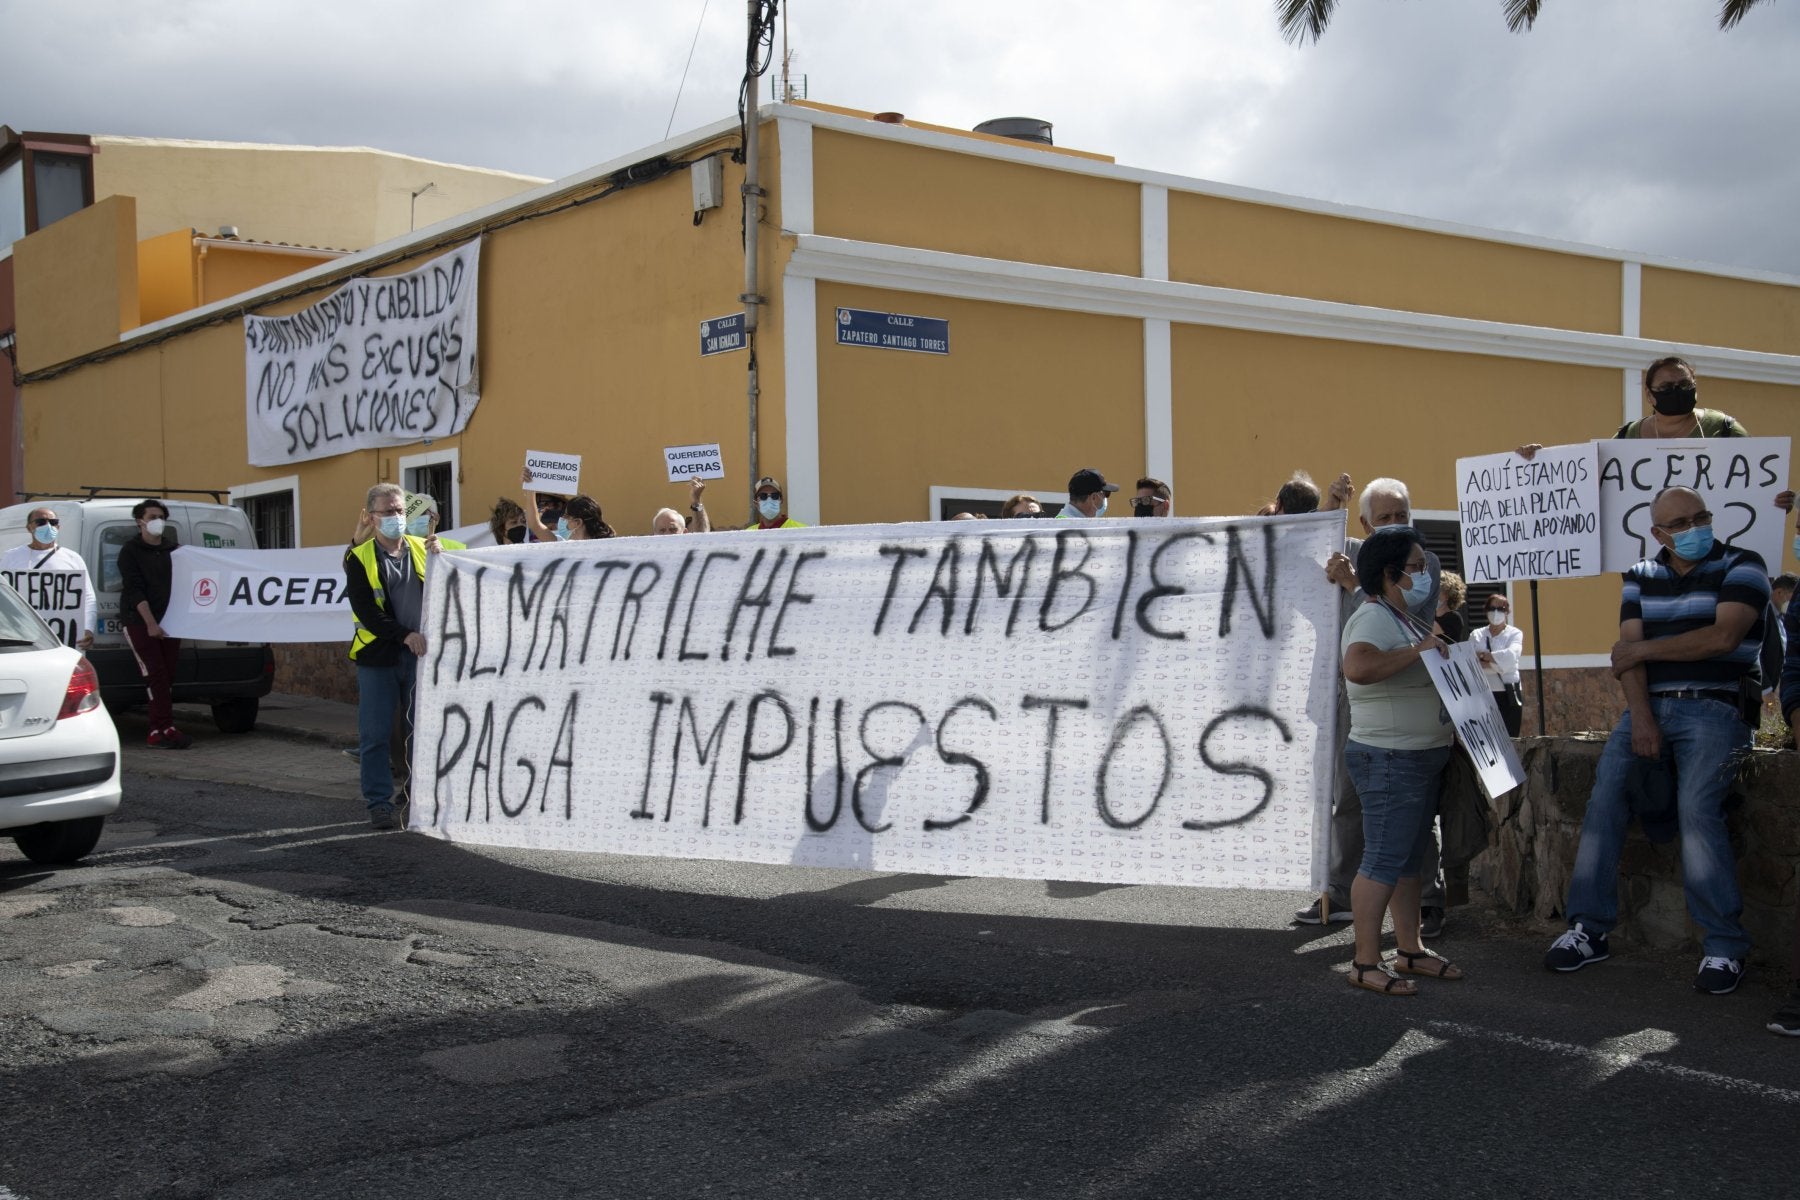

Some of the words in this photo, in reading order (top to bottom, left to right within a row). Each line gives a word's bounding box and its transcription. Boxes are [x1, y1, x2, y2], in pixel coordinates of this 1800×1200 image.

[375, 257, 464, 322] CABILDO
[717, 317, 737, 330] CALLE
[887, 316, 914, 328] CALLE
[707, 338, 718, 352] SAN
[719, 332, 740, 350] IGNACIO
[842, 329, 878, 344] ZAPATERO
[882, 334, 917, 348] SANTIAGO
[920, 338, 946, 351] TORRES
[256, 360, 296, 416] NO
[527, 458, 578, 472] QUEREMOS
[668, 449, 719, 461] QUEREMOS
[671, 462, 721, 475] ACERAS
[1466, 458, 1511, 494] AQUÍ
[1515, 457, 1588, 487] ESTAMOS
[1600, 454, 1780, 492] ACERAS
[1460, 499, 1494, 524] HOYA
[1530, 488, 1581, 514] PLATA
[1465, 520, 1530, 547] ORIGINAL
[1533, 512, 1596, 538] APOYANDO
[1473, 548, 1581, 581] ALMATRICHE
[434, 548, 826, 685] ALMATRICHE
[874, 523, 1274, 640] TAMBIEN
[1440, 660, 1472, 701] NO
[432, 690, 579, 826] PAGA
[630, 688, 1292, 834] IMPUESTOS
